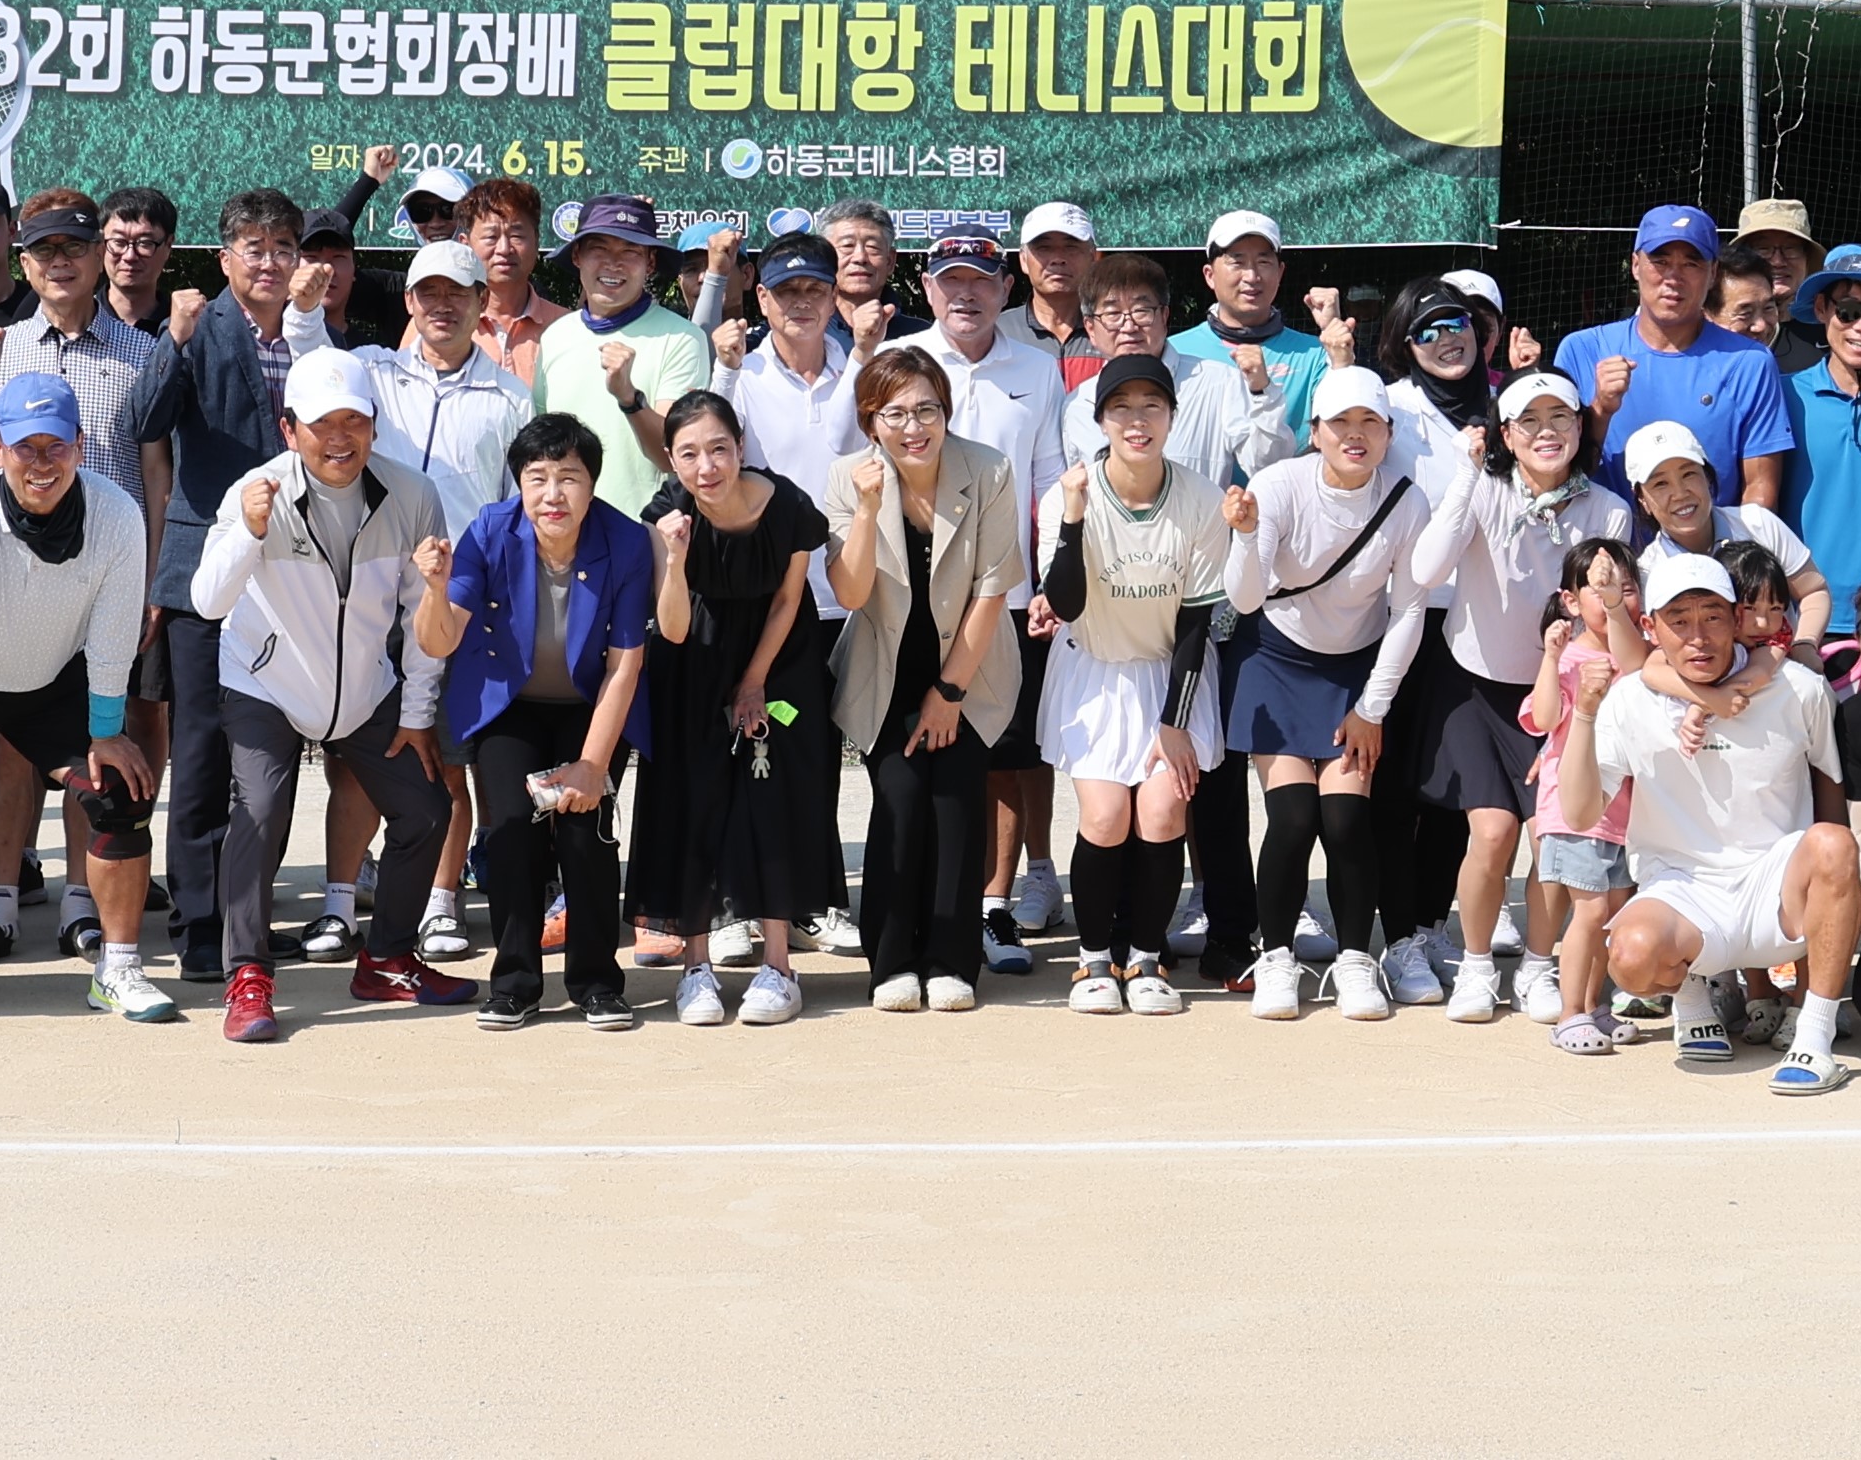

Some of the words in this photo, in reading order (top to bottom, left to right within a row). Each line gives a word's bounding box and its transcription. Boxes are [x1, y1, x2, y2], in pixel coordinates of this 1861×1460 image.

[150, 5, 577, 96] 하동군협회장배
[604, 3, 923, 112] 클럽대항
[954, 2, 1323, 113] 테니스대회
[310, 143, 360, 171] 일자
[638, 146, 688, 174] 주관
[766, 144, 1005, 178] 하동군테니스협회
[1111, 582, 1178, 599] DIADORA
